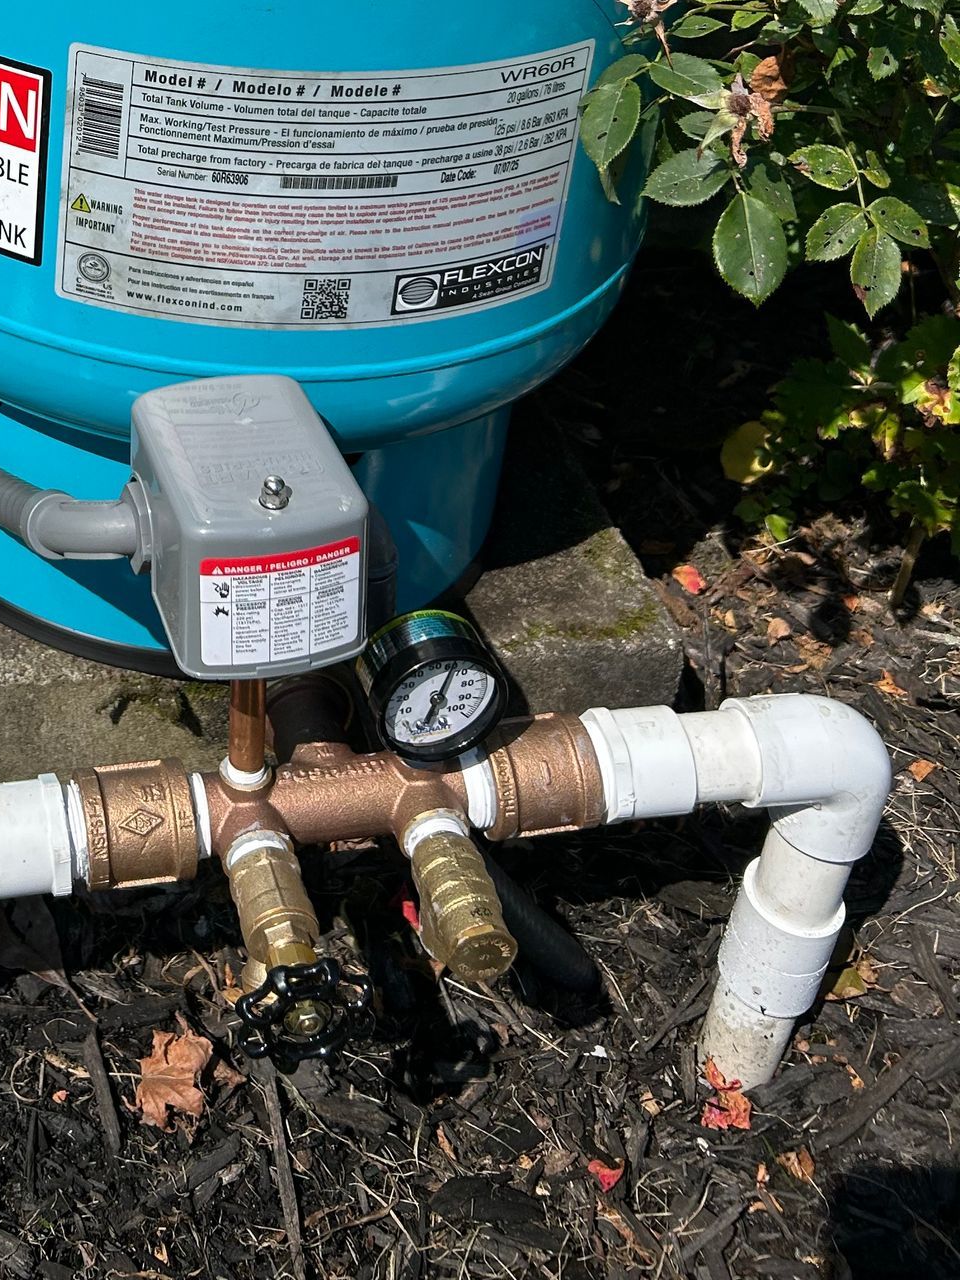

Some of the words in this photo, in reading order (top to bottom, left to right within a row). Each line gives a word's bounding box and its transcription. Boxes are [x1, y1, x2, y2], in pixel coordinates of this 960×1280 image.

[501, 56, 575, 84] WR60R
[145, 70, 192, 88] Model
[197, 78, 206, 89] #
[215, 79, 222, 91] /
[233, 81, 291, 96] Modelo
[296, 85, 305, 96] #
[313, 85, 320, 97] /
[331, 85, 388, 98] Modele
[392, 84, 401, 96] #
[507, 93, 516, 104] 20
[516, 88, 539, 104] gallons
[543, 84, 552, 95] 76
[142, 93, 163, 104] Total
[166, 96, 187, 107] Tank
[190, 100, 224, 111] Volume
[234, 104, 274, 115] Volumen
[278, 108, 298, 117] total
[301, 108, 315, 117] del
[319, 109, 350, 119] tanque
[360, 108, 399, 119] Capacite
[402, 106, 427, 115] totale
[140, 113, 162, 124] Max.
[165, 117, 226, 132] Working/Test
[229, 124, 270, 136] Pressure
[281, 128, 290, 137] El
[293, 128, 365, 138] funcionamiento
[368, 129, 379, 137] de
[382, 128, 417, 137] máximo
[426, 123, 455, 135] prueba
[457, 121, 467, 131] de
[469, 117, 498, 130] presión
[493, 123, 505, 136] 125
[506, 121, 517, 136] psi
[521, 118, 532, 131] 8.6
[532, 115, 543, 128] Bar
[139, 124, 211, 142] Fonctionnement
[213, 134, 301, 149] Maximum/Pression
[138, 144, 158, 155] Total
[161, 150, 207, 163] precharge
[210, 155, 231, 165] from
[234, 156, 266, 169] factory
[276, 159, 317, 171] Precarga
[320, 161, 330, 170] de
[333, 160, 364, 170] fabrica
[367, 160, 380, 169] del
[383, 159, 413, 169] tanque
[421, 152, 463, 167] precharge
[472, 149, 493, 159] usine
[503, 143, 514, 158] psi
[518, 140, 528, 152] 2.6
[529, 137, 539, 149] Bar
[157, 167, 177, 178] Serial
[178, 170, 208, 181] Number:
[441, 170, 456, 183] Date
[457, 168, 477, 181] Code:
[493, 159, 519, 175] 07/07/25
[91, 199, 123, 215] WARNING
[76, 216, 116, 234] IMPORTANT
[129, 266, 141, 274] Para
[142, 268, 179, 280] instrucciones
[443, 247, 543, 286] FLEXCON
[128, 277, 140, 286] Pour
[151, 282, 180, 291] instruction
[441, 267, 540, 297] INDUSTRIES
[127, 290, 242, 312] www.flexconind.com
[224, 565, 262, 574] DANGER
[270, 558, 308, 570] PELIGRO
[316, 547, 350, 563] DANGER
[455, 669, 467, 677] 70
[461, 680, 474, 688] 80
[396, 694, 409, 703] 20
[459, 693, 471, 702] 90
[399, 707, 412, 715] 10
[446, 704, 465, 713] 100
